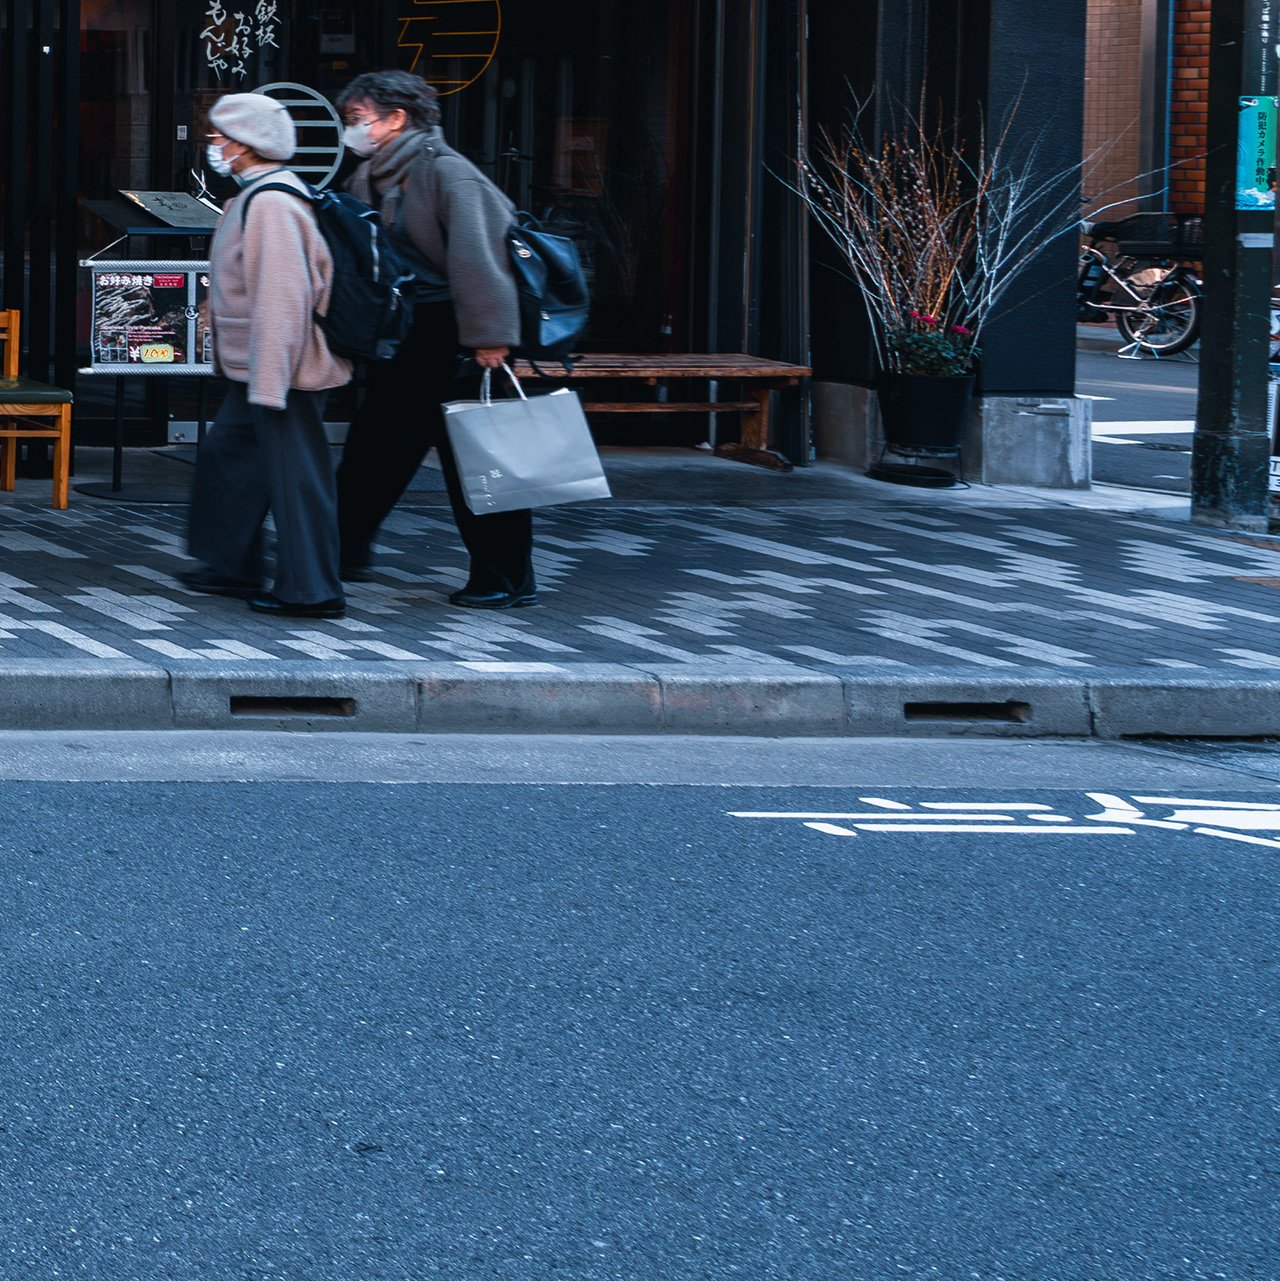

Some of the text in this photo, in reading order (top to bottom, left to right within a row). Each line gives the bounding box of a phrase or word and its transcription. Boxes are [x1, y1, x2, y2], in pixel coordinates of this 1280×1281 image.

[225, 11, 253, 81] お好み
[1256, 112, 1267, 185] 防犯カメラ作動中
[100, 275, 153, 287] お好み焼き
